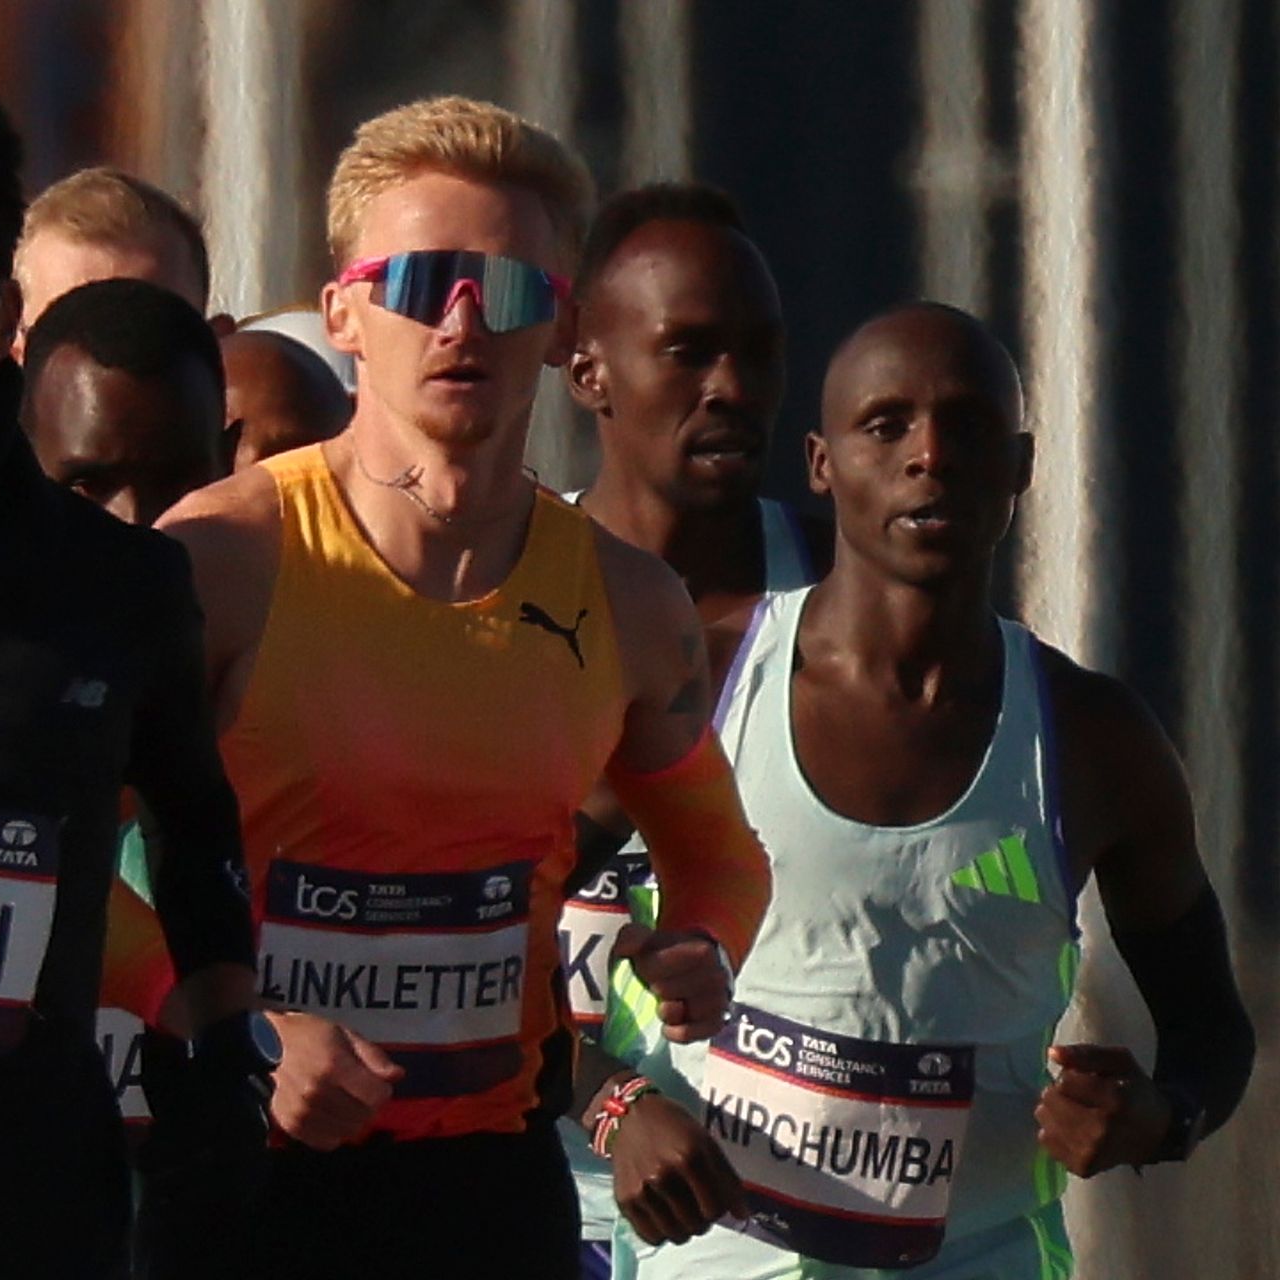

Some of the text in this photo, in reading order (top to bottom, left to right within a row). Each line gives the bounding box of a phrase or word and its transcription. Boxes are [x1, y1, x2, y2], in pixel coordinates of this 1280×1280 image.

[297, 873, 359, 921] tcs
[261, 954, 524, 1011] LINKLETTER
[737, 1014, 794, 1068] tcs
[801, 1034, 838, 1055] TATA
[795, 1060, 851, 1085] SERVICES
[798, 1049, 887, 1077] CONSULTANCY
[910, 1078, 952, 1094] TATA
[705, 1086, 954, 1187] KIPCHUMBA
